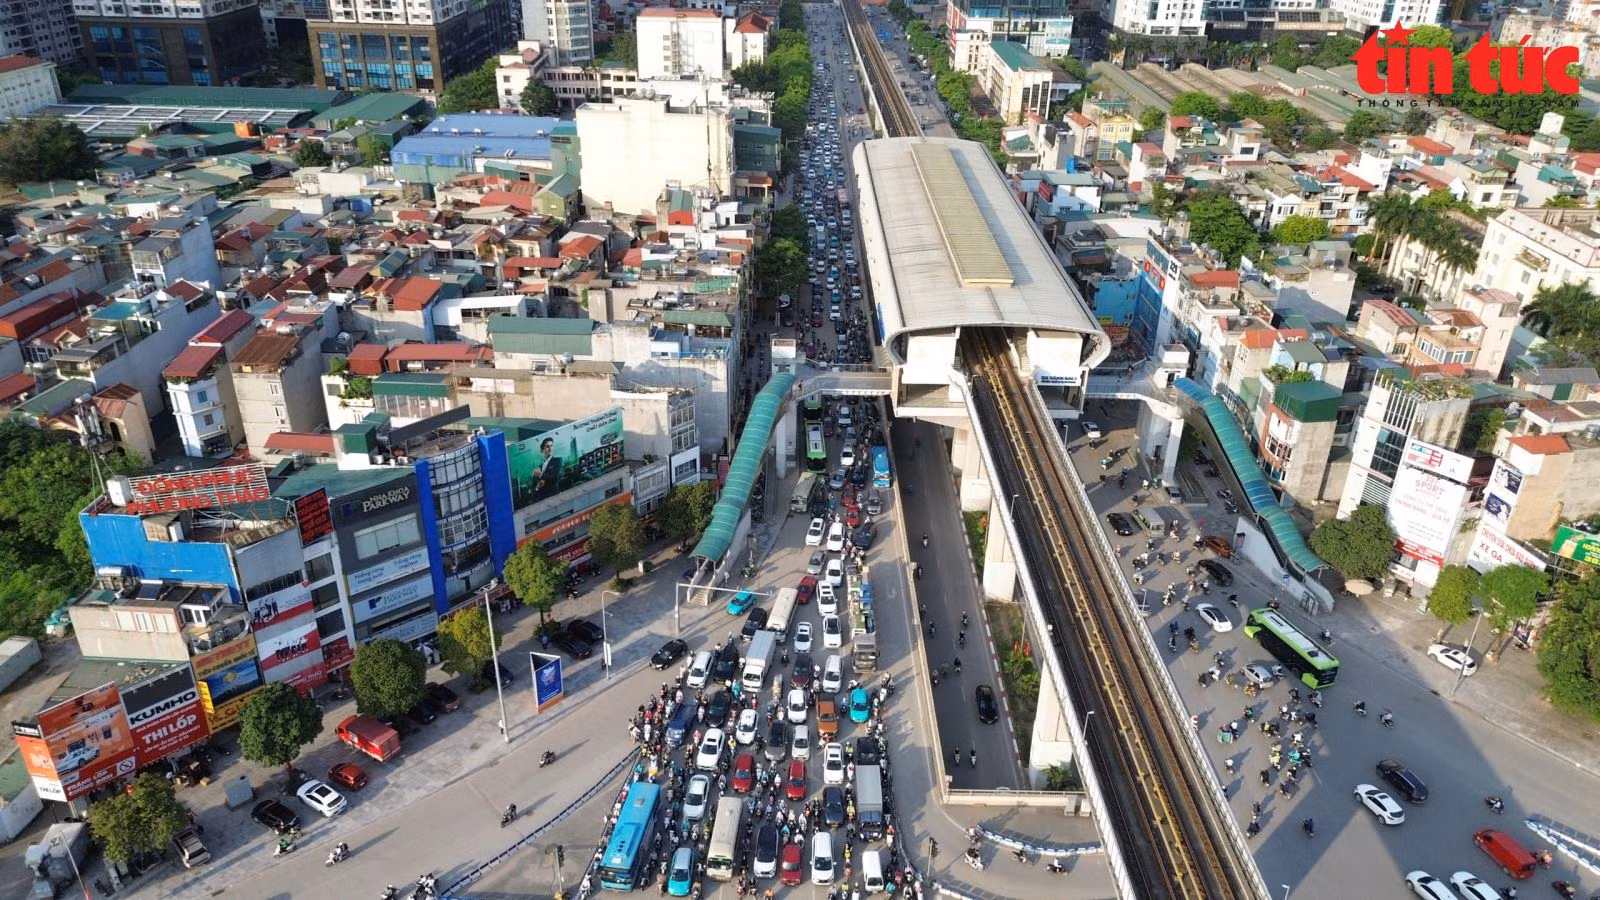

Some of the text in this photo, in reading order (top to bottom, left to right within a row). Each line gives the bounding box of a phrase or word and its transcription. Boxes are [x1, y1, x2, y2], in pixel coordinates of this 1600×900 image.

[369, 486, 411, 502] NHA KHOA
[1415, 479, 1446, 496] SPORT
[362, 492, 410, 513] PARKWAY
[1480, 542, 1490, 553] XE
[1490, 549, 1503, 562] GA
[384, 589, 418, 605] PARKWAY
[129, 691, 196, 725] KUMHO
[143, 726, 169, 745] THI
[169, 713, 197, 733] LỐP
